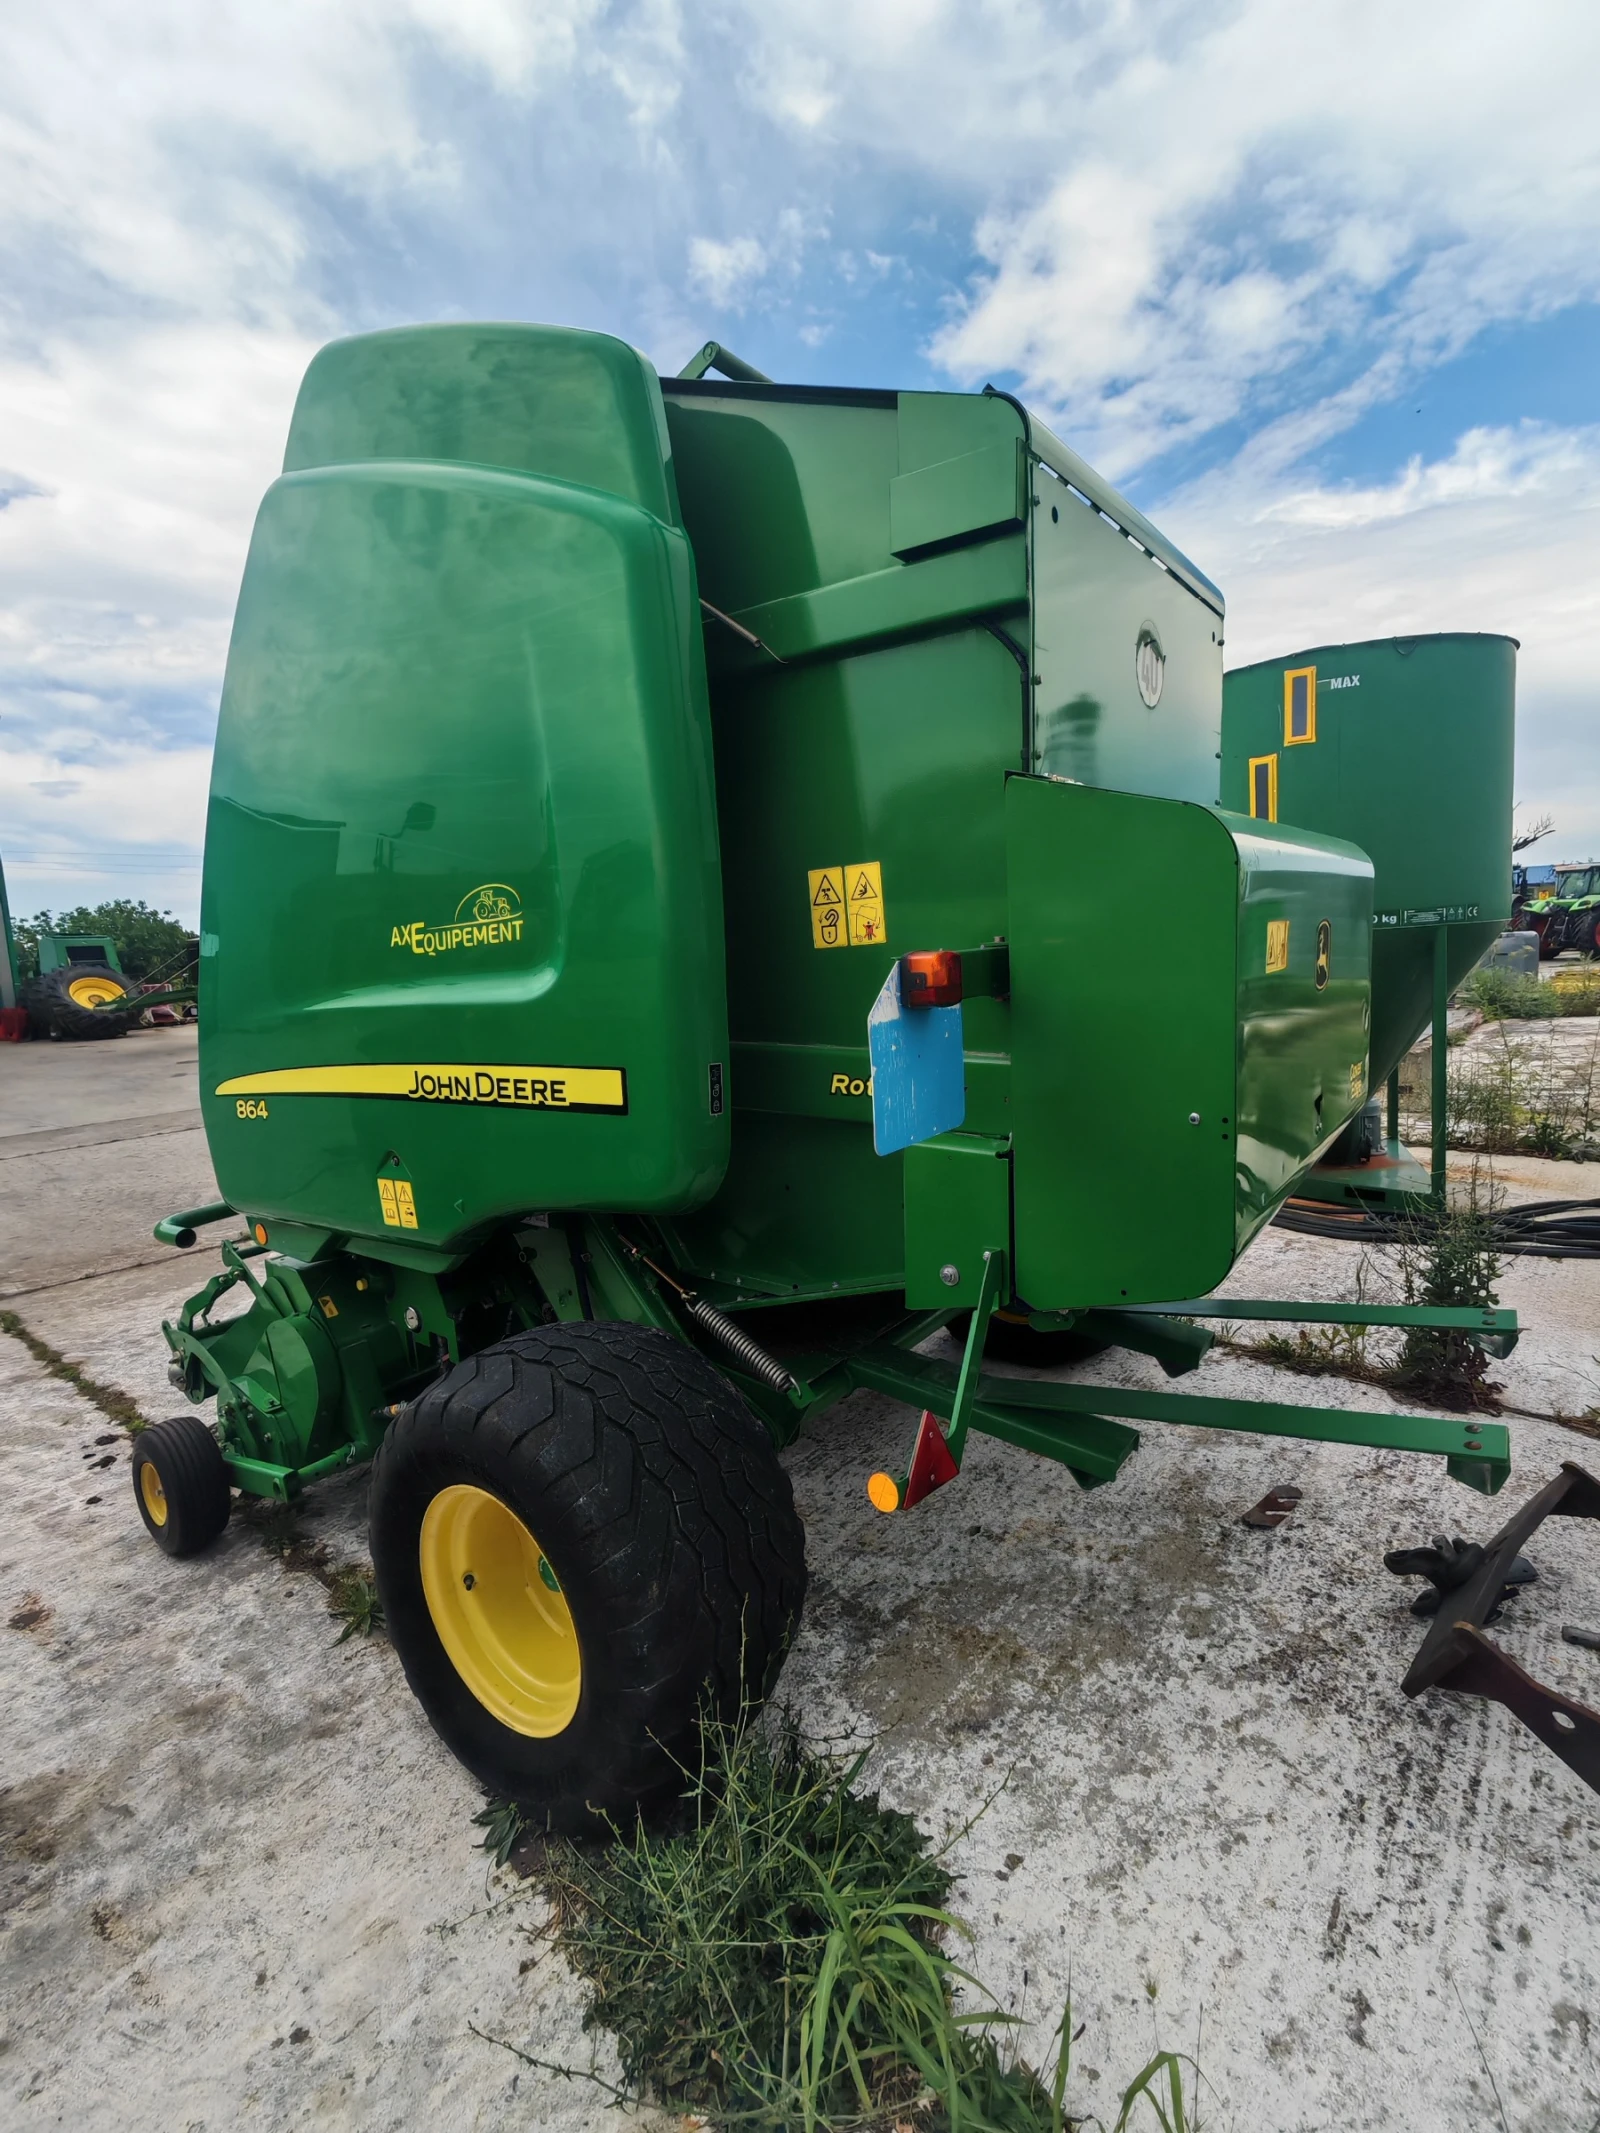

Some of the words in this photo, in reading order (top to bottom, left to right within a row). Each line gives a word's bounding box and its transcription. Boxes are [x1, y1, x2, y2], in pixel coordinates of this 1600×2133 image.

[1331, 675, 1360, 690] MAX
[1382, 913, 1397, 925] kg
[408, 1070, 471, 1098] JOHN
[475, 1072, 567, 1103] DEERE
[236, 1099, 269, 1120] 864
